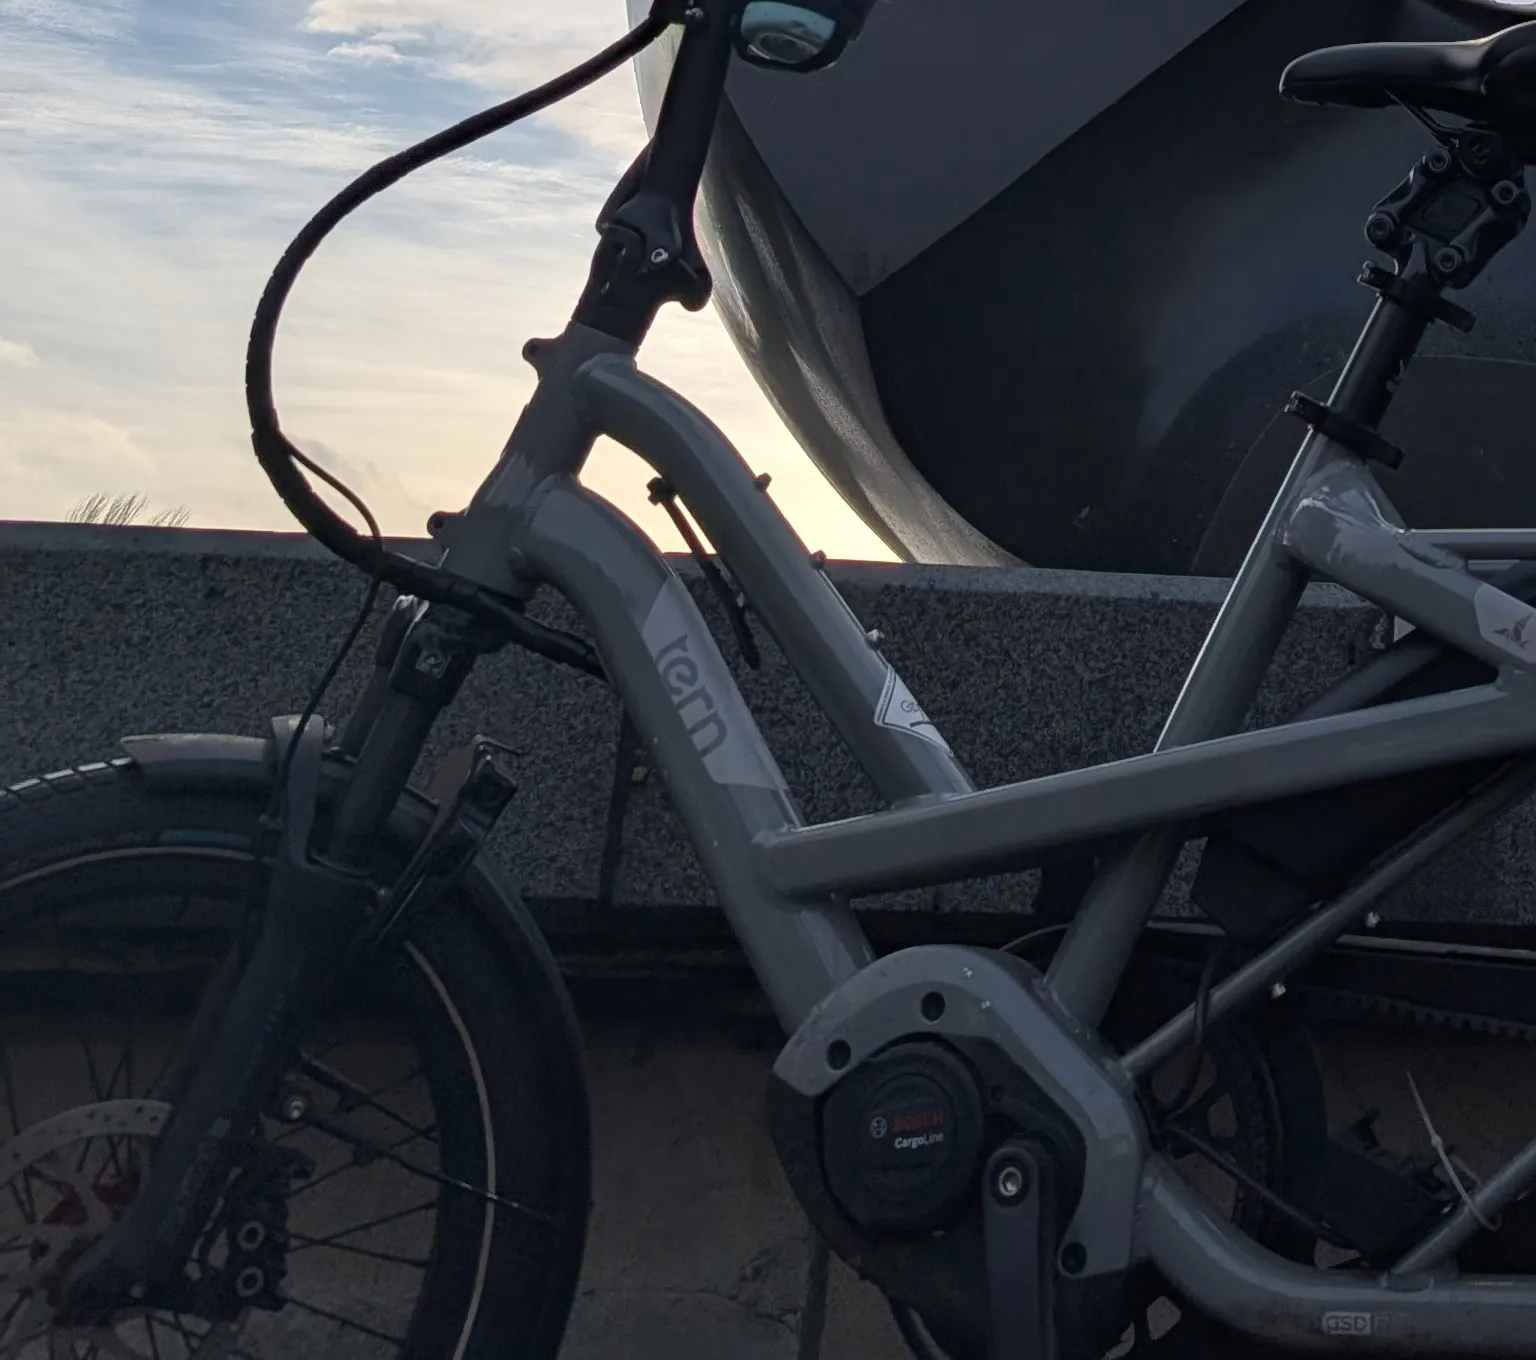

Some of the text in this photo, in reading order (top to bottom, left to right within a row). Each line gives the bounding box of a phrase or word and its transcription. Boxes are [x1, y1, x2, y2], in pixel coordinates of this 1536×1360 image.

[655, 633, 729, 758] tern
[894, 1132, 945, 1149] CargoLine
[1325, 1315, 1368, 1331] GSD
